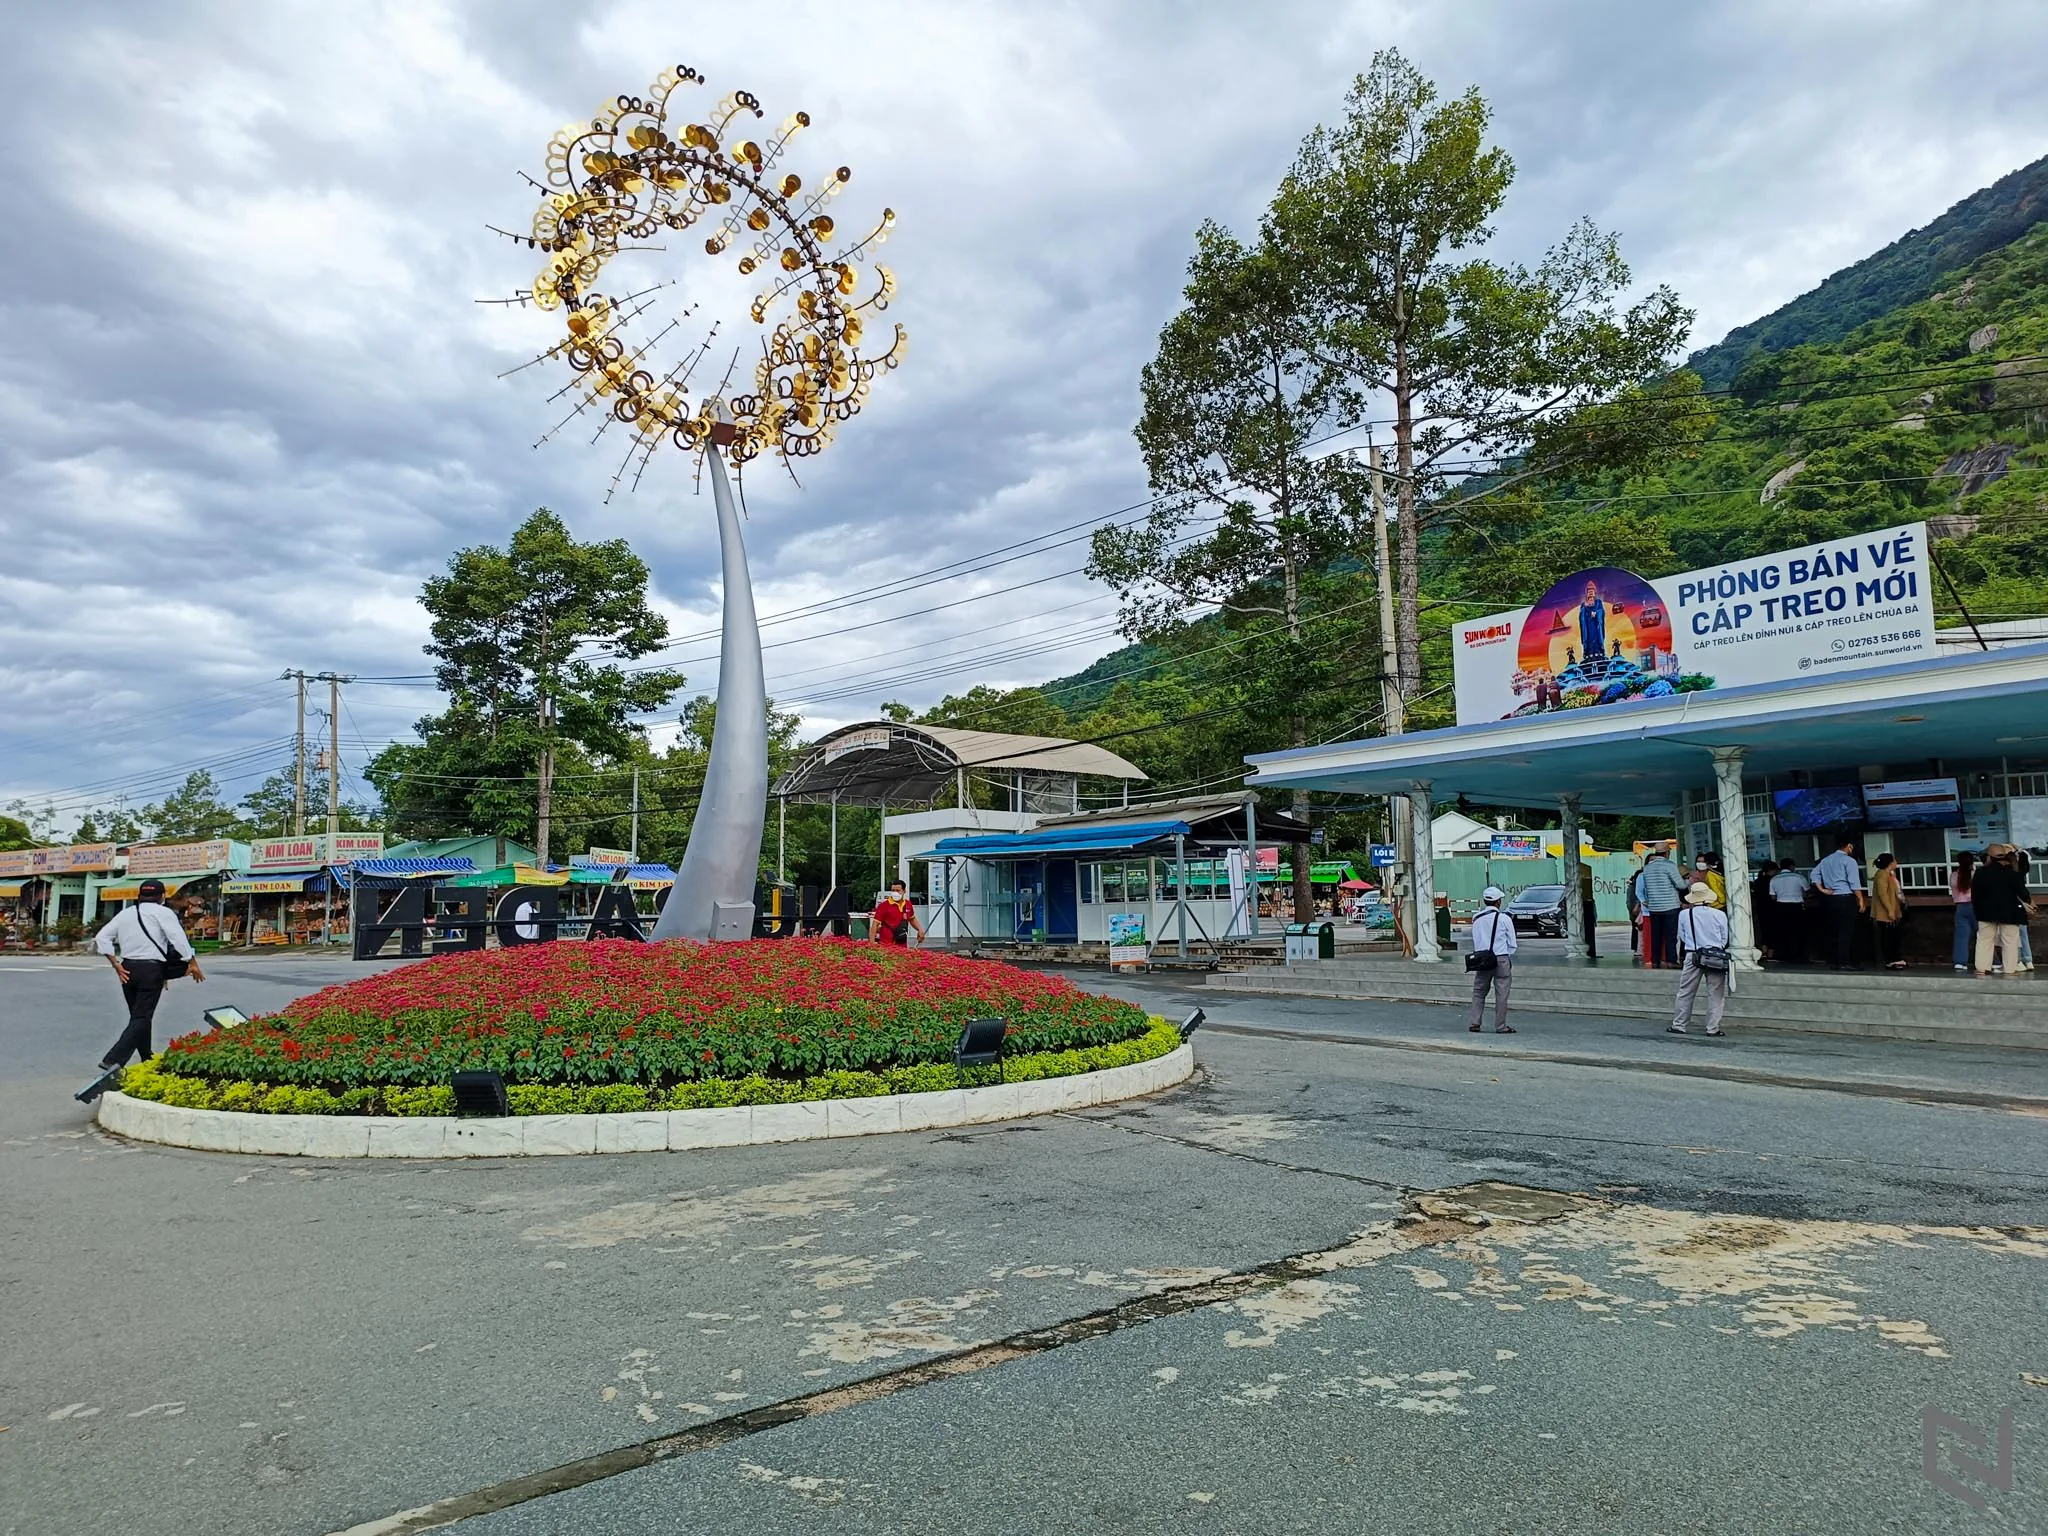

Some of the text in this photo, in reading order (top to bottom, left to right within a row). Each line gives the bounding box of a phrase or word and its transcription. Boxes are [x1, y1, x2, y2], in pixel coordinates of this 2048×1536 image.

[1678, 531, 1915, 607] PHÒNG BÁN VÉ
[1692, 568, 1917, 635] CÁP TREO MỚI
[1712, 636, 1735, 646] TREO
[1796, 624, 1802, 632] &
[1826, 616, 1851, 627] TREO
[1848, 629, 1922, 648] 02763 536 666
[265, 841, 313, 859] KIM LOAN
[336, 839, 379, 849] KIM LOAN
[254, 883, 268, 891] KIM
[270, 882, 291, 890] LOAN
